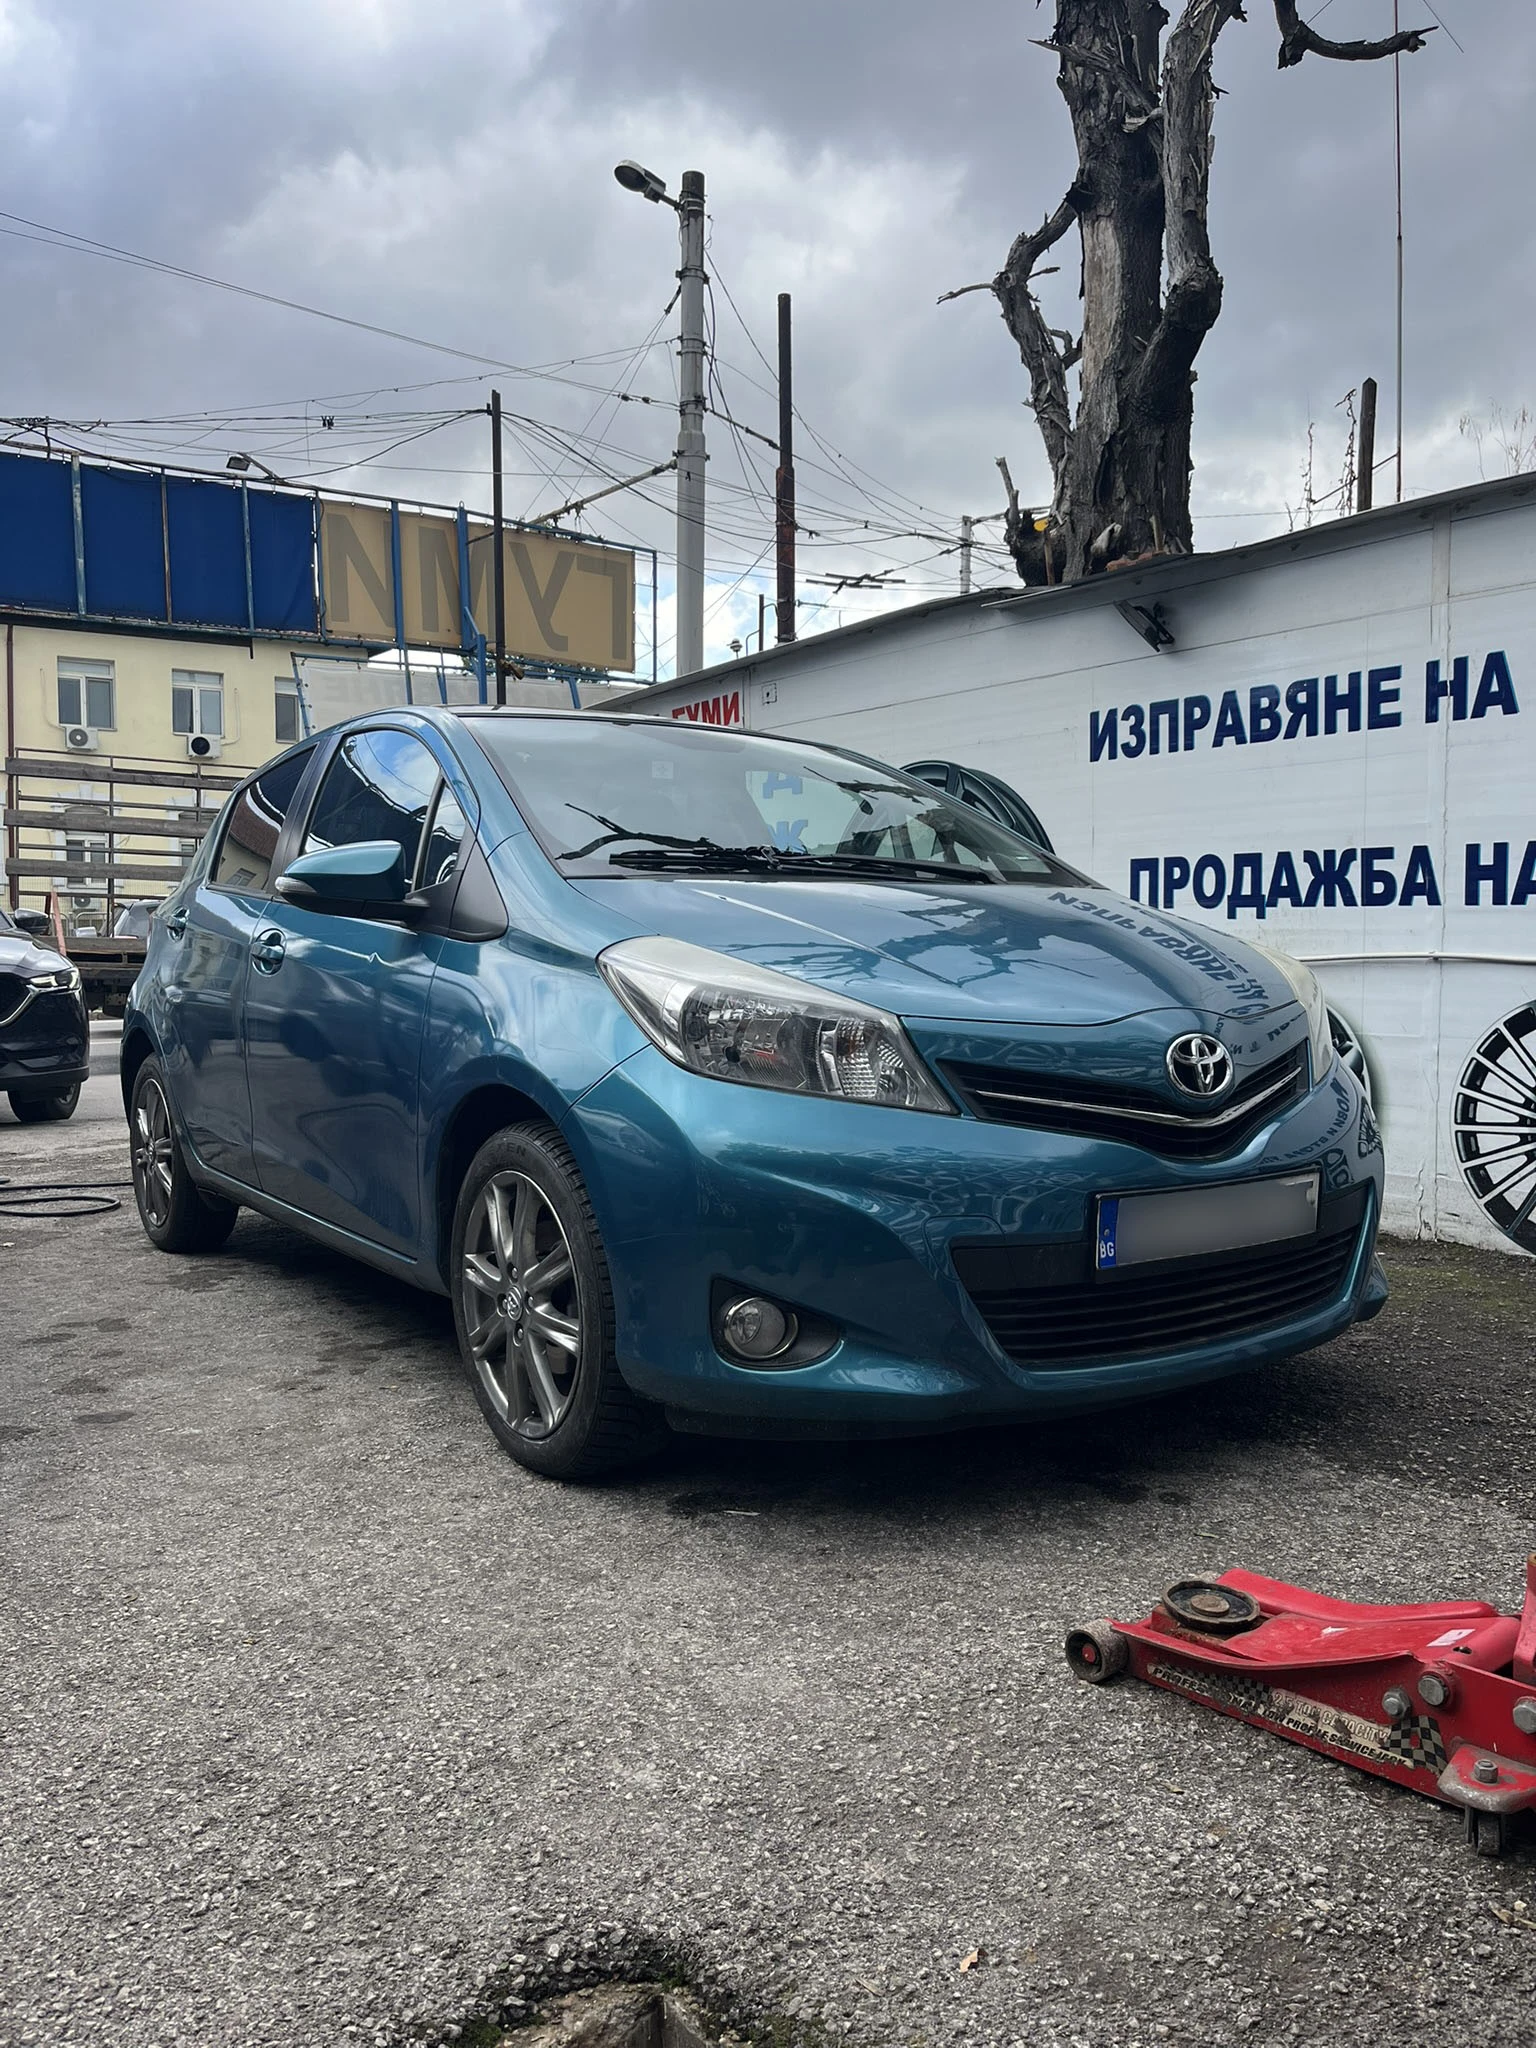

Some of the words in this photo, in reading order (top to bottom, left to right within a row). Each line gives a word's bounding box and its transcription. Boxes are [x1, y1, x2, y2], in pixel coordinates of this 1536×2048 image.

[1089, 665, 1402, 763] ИЗПРАВЯНЕ
[1424, 650, 1520, 724] НА
[1130, 845, 1442, 919] ПРОДАЖБА
[1464, 840, 1536, 906] НА
[1099, 1241, 1115, 1258] BG
